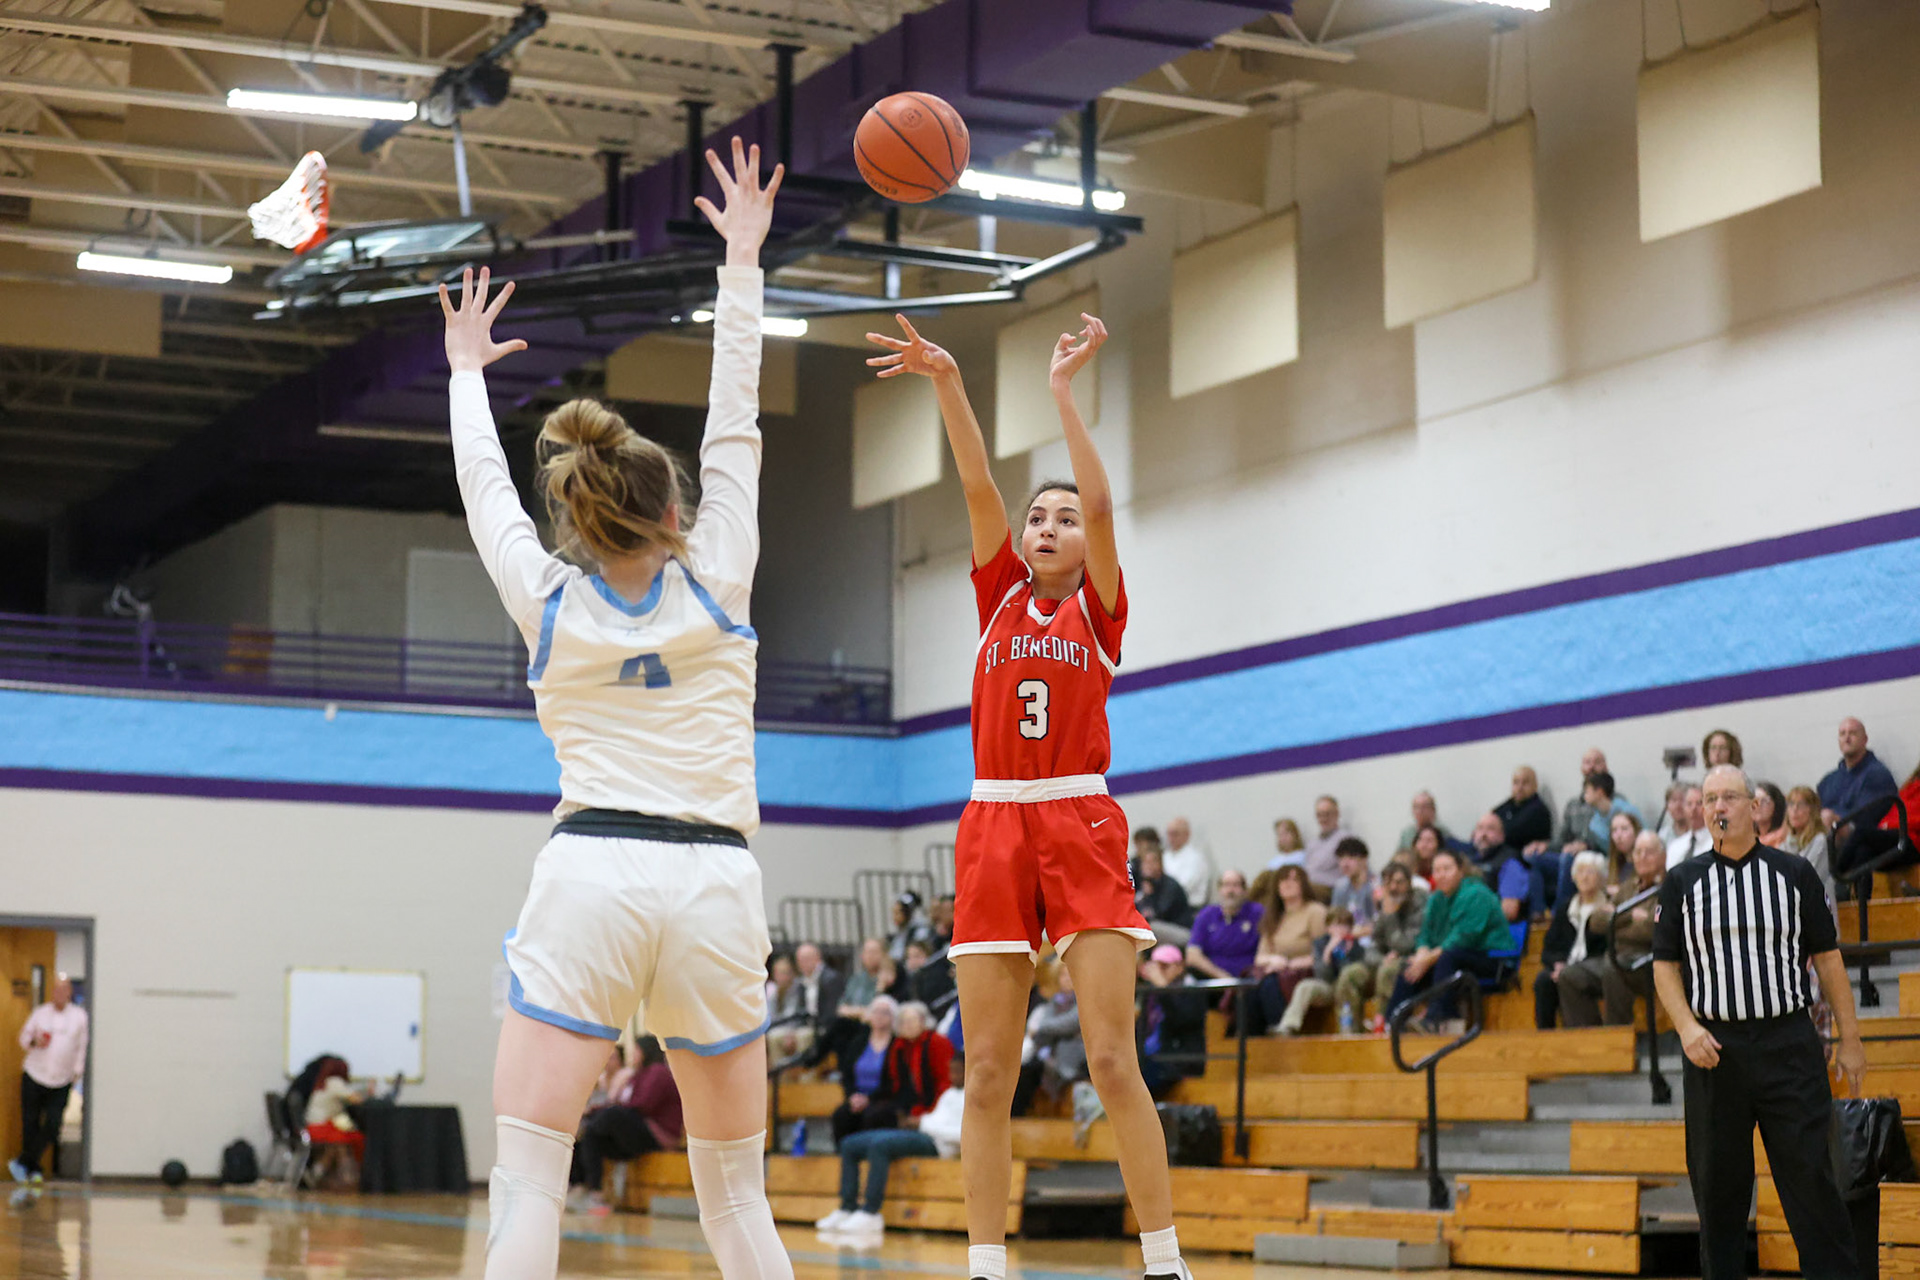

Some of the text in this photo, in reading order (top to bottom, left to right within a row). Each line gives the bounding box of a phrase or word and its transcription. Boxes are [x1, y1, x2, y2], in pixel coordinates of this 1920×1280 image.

[985, 634, 1090, 674] ST. BENEDICT
[1017, 679, 1049, 740] 3
